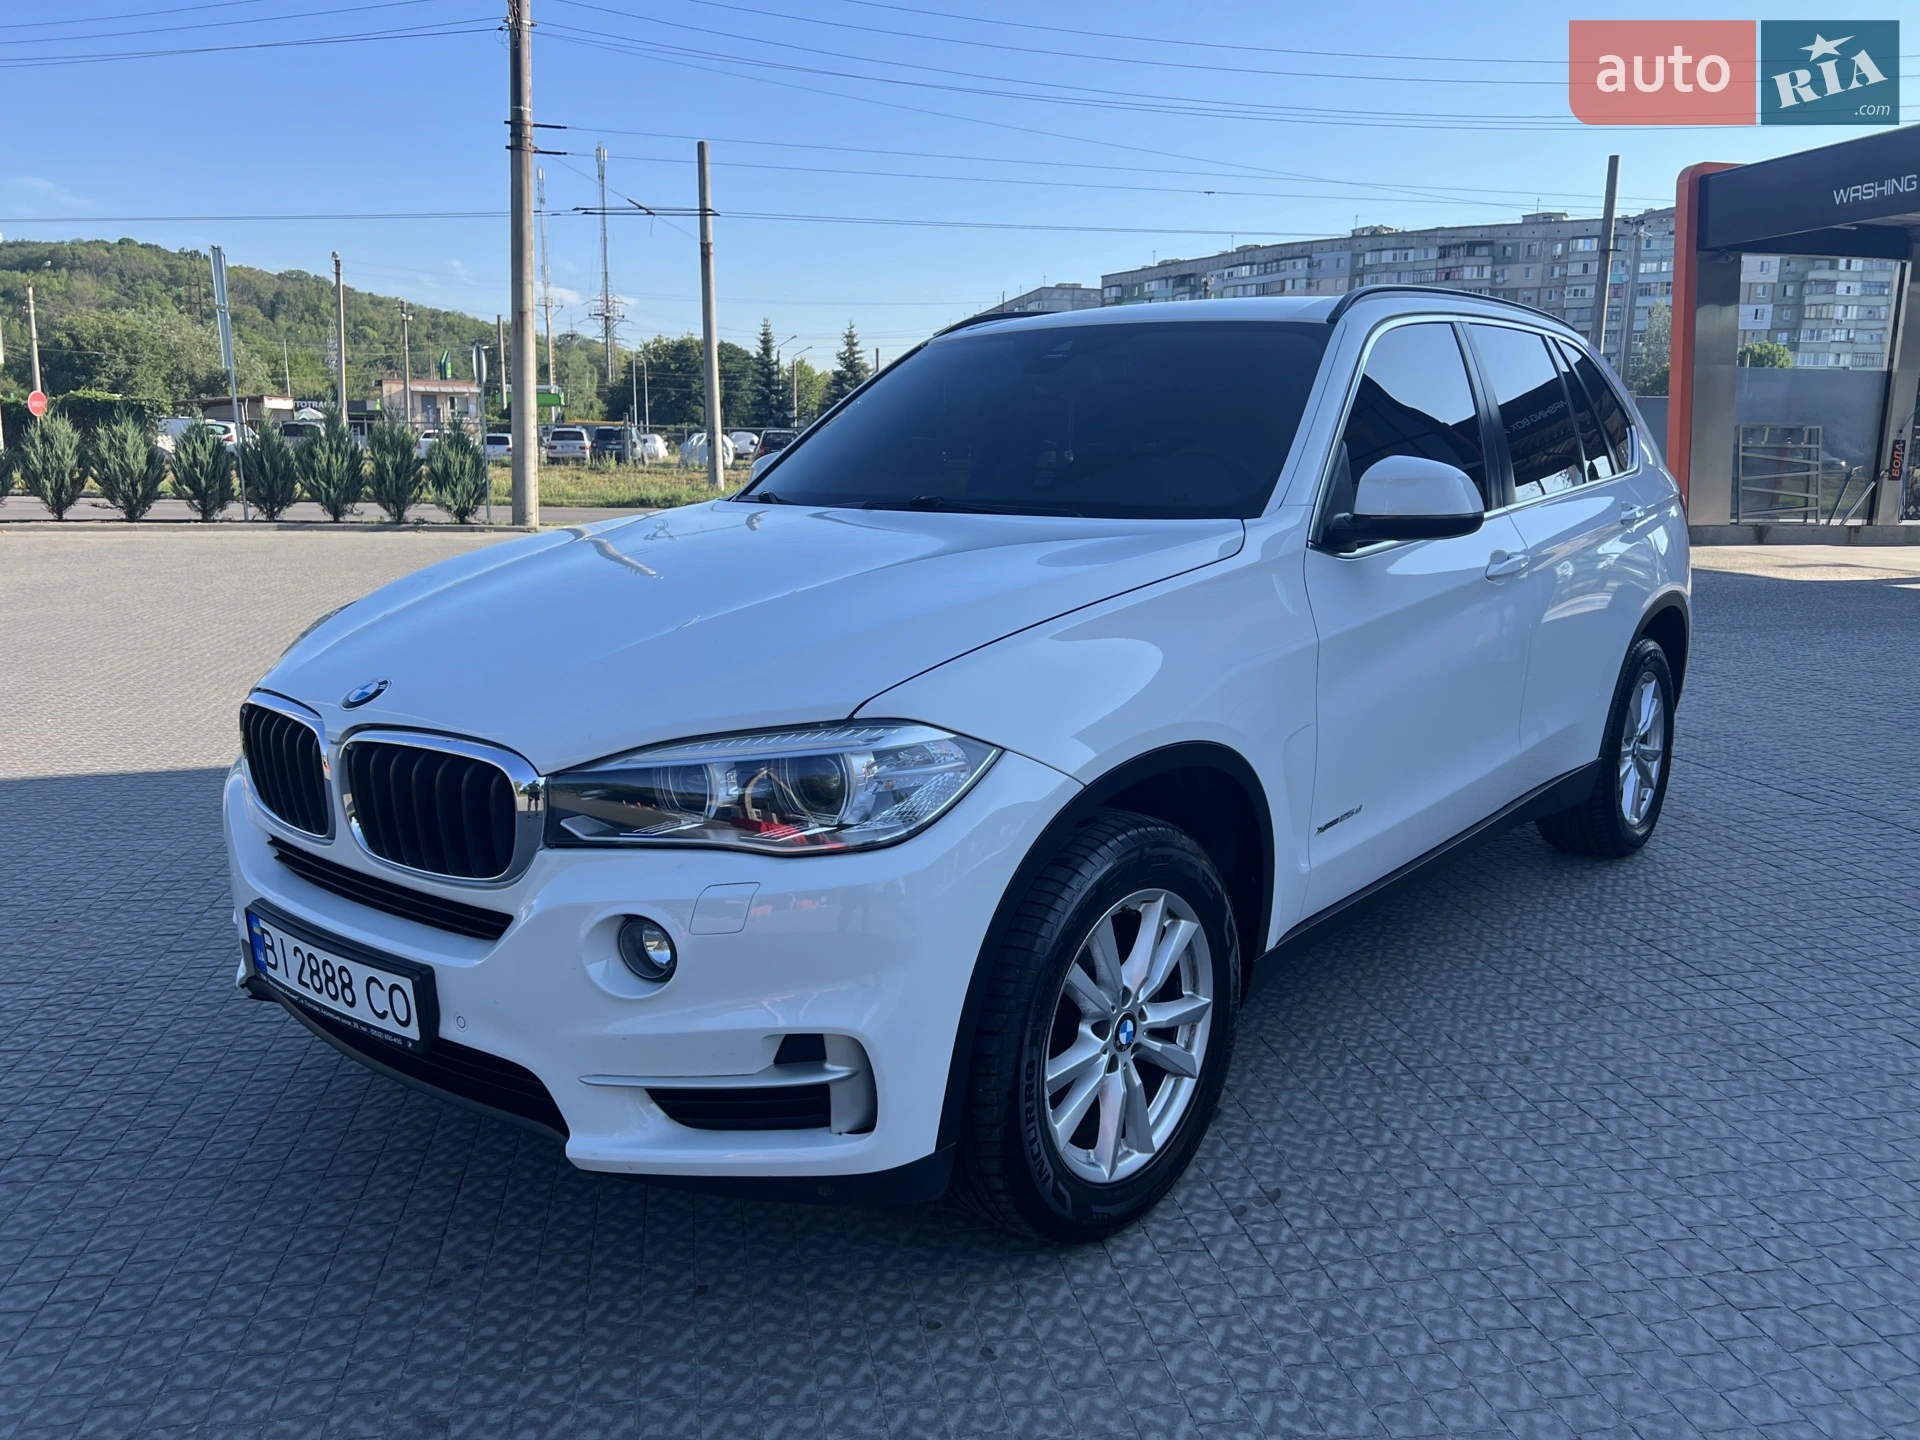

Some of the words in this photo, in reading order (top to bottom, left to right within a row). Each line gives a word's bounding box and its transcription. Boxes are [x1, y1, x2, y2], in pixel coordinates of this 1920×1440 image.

[1833, 174, 1917, 205] WASHING
[293, 946, 356, 1008] 2888
[365, 976, 411, 1027] CO
